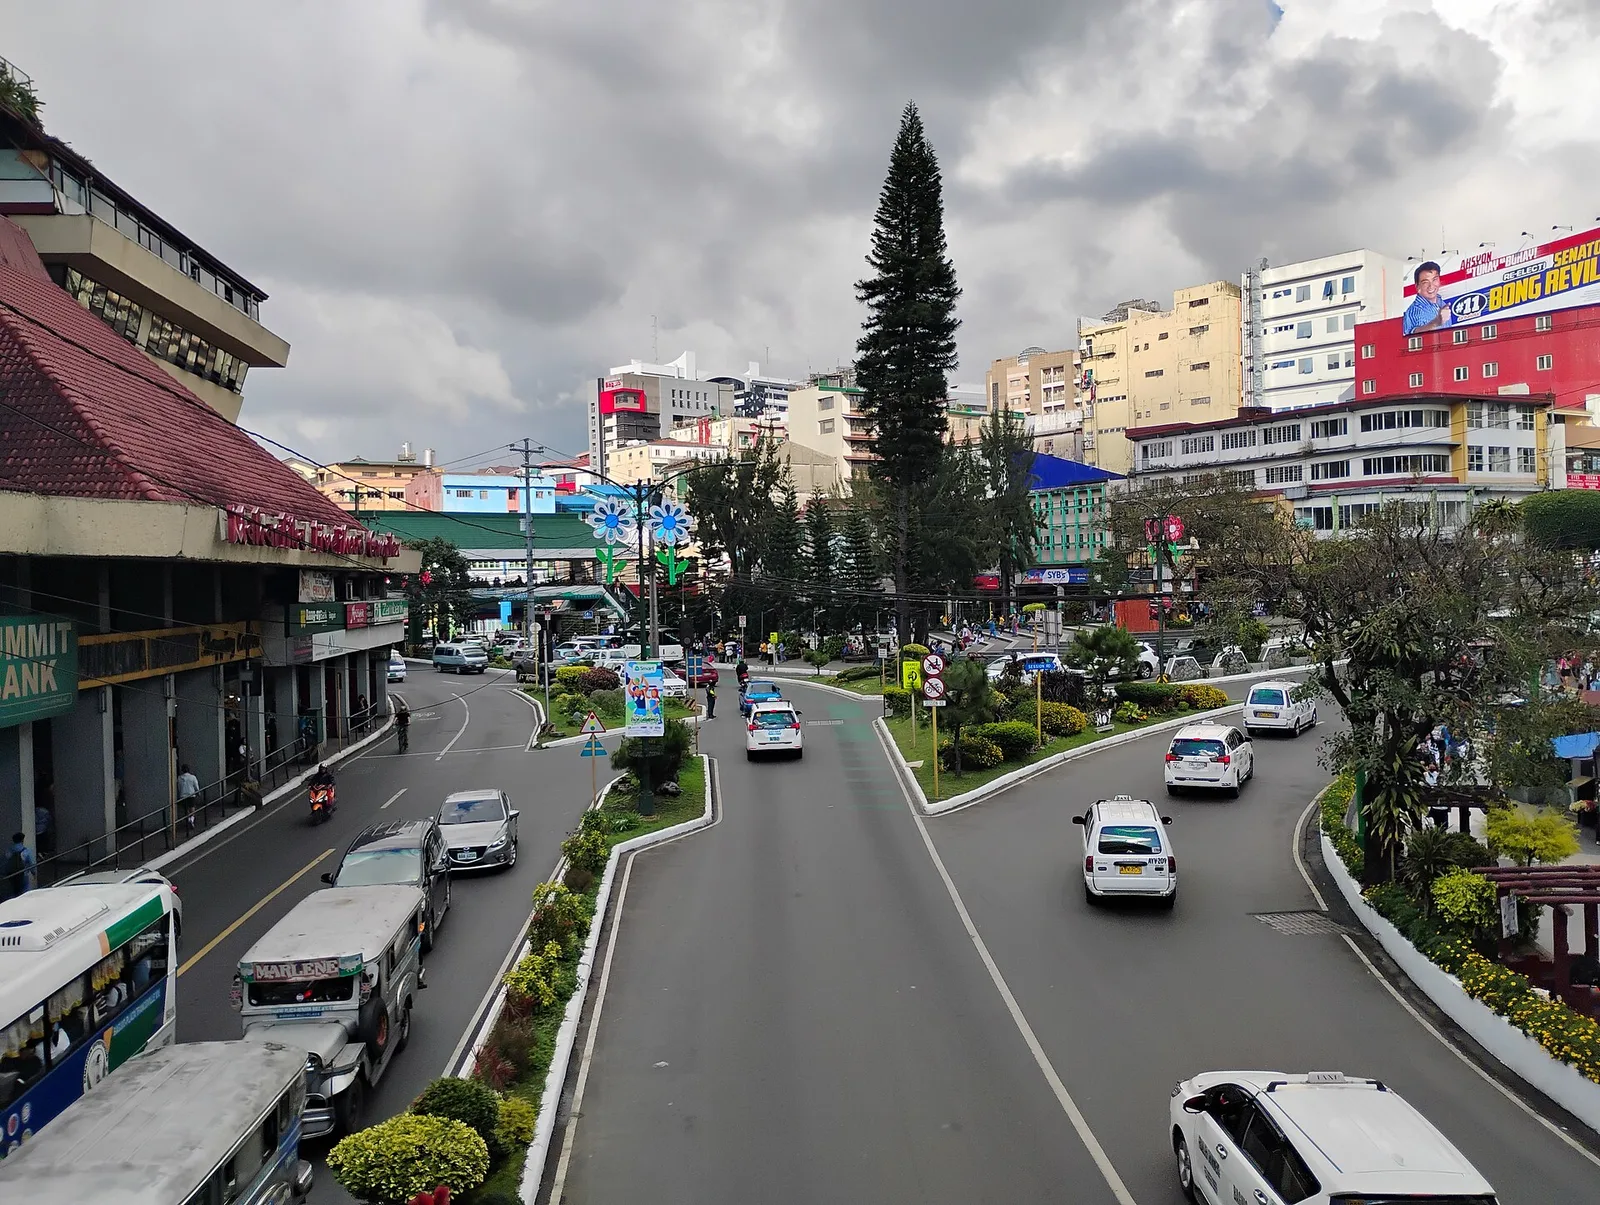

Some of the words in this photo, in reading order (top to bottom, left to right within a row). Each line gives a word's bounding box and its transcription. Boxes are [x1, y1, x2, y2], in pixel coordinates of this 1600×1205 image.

[1460, 251, 1493, 270] AKSYON
[1472, 257, 1500, 278] TUNAY
[1505, 247, 1537, 267] BUHAY!
[1455, 295, 1480, 314] #11
[1489, 274, 1542, 312] BONG
[0, 622, 72, 660] MMIT
[0, 659, 58, 700] ANK
[255, 960, 339, 980] MARLENE
